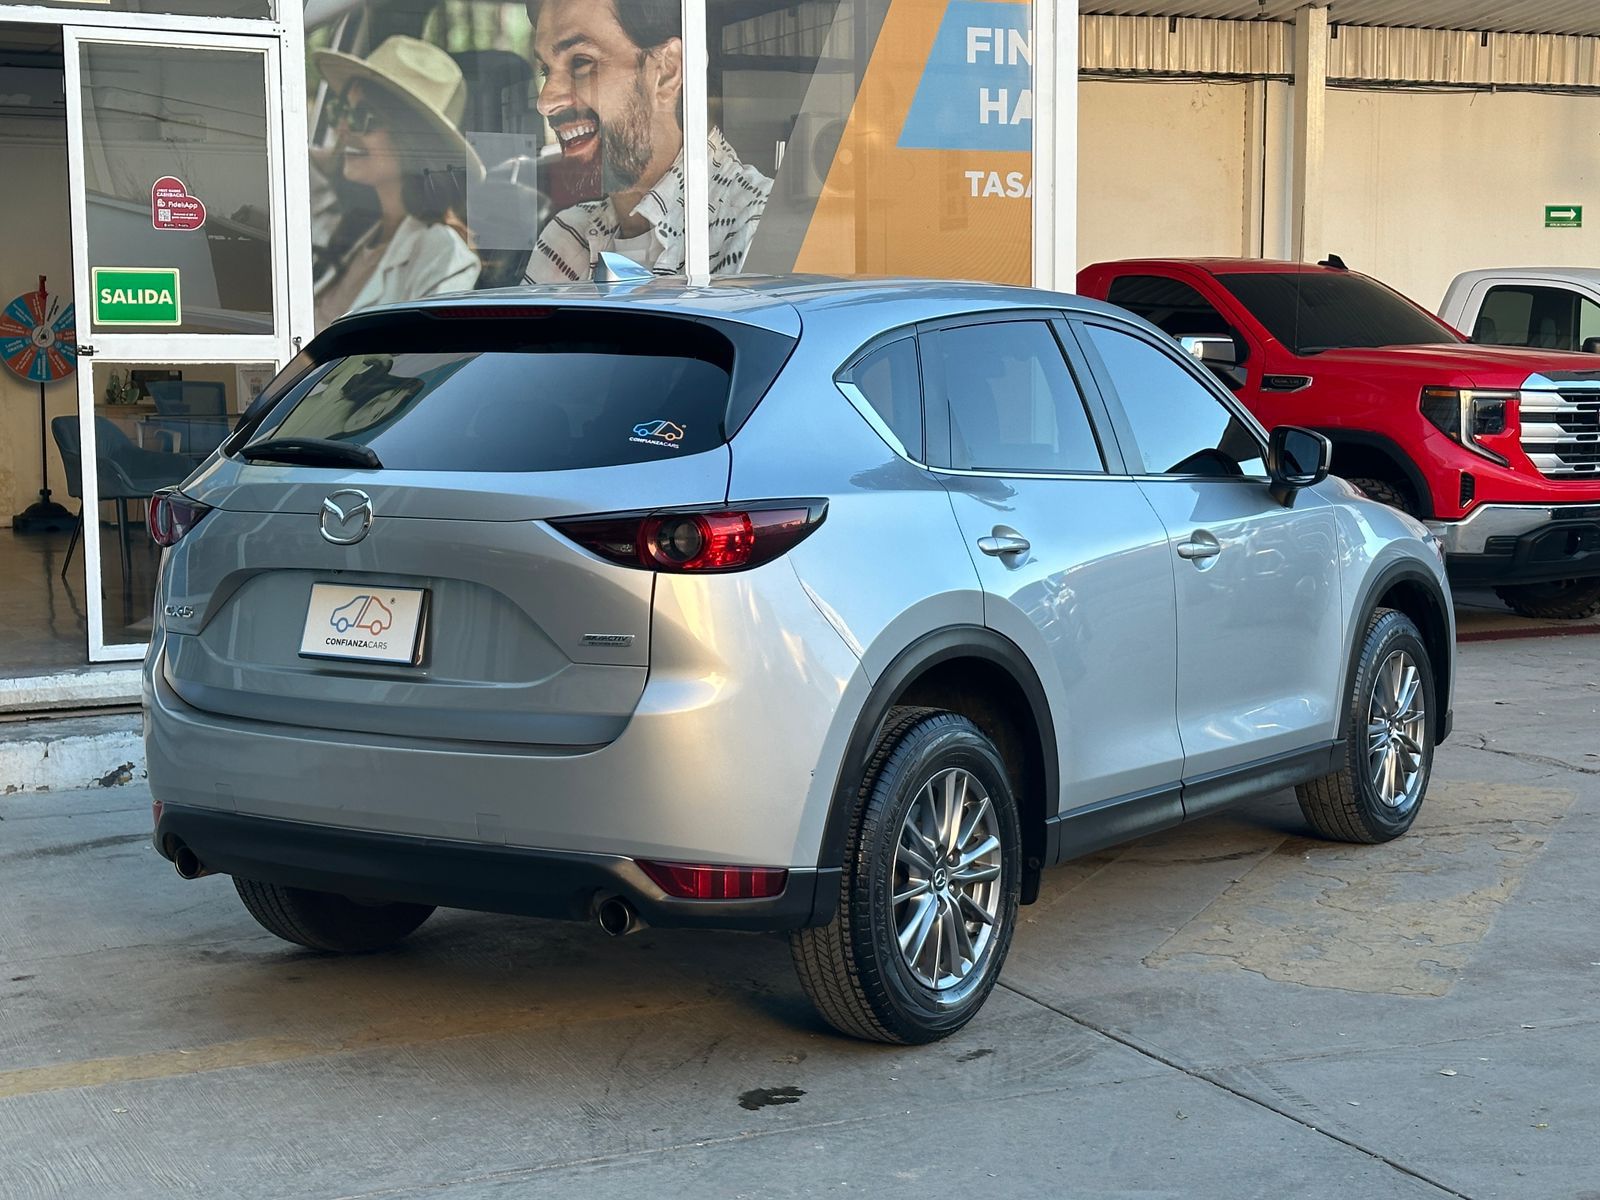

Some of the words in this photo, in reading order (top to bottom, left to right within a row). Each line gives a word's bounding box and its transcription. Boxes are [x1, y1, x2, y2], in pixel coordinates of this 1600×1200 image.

[100, 288, 174, 305] SALIDA
[628, 436, 680, 449] CONFIANZACARS
[325, 637, 388, 650] CONFIANZACARS
